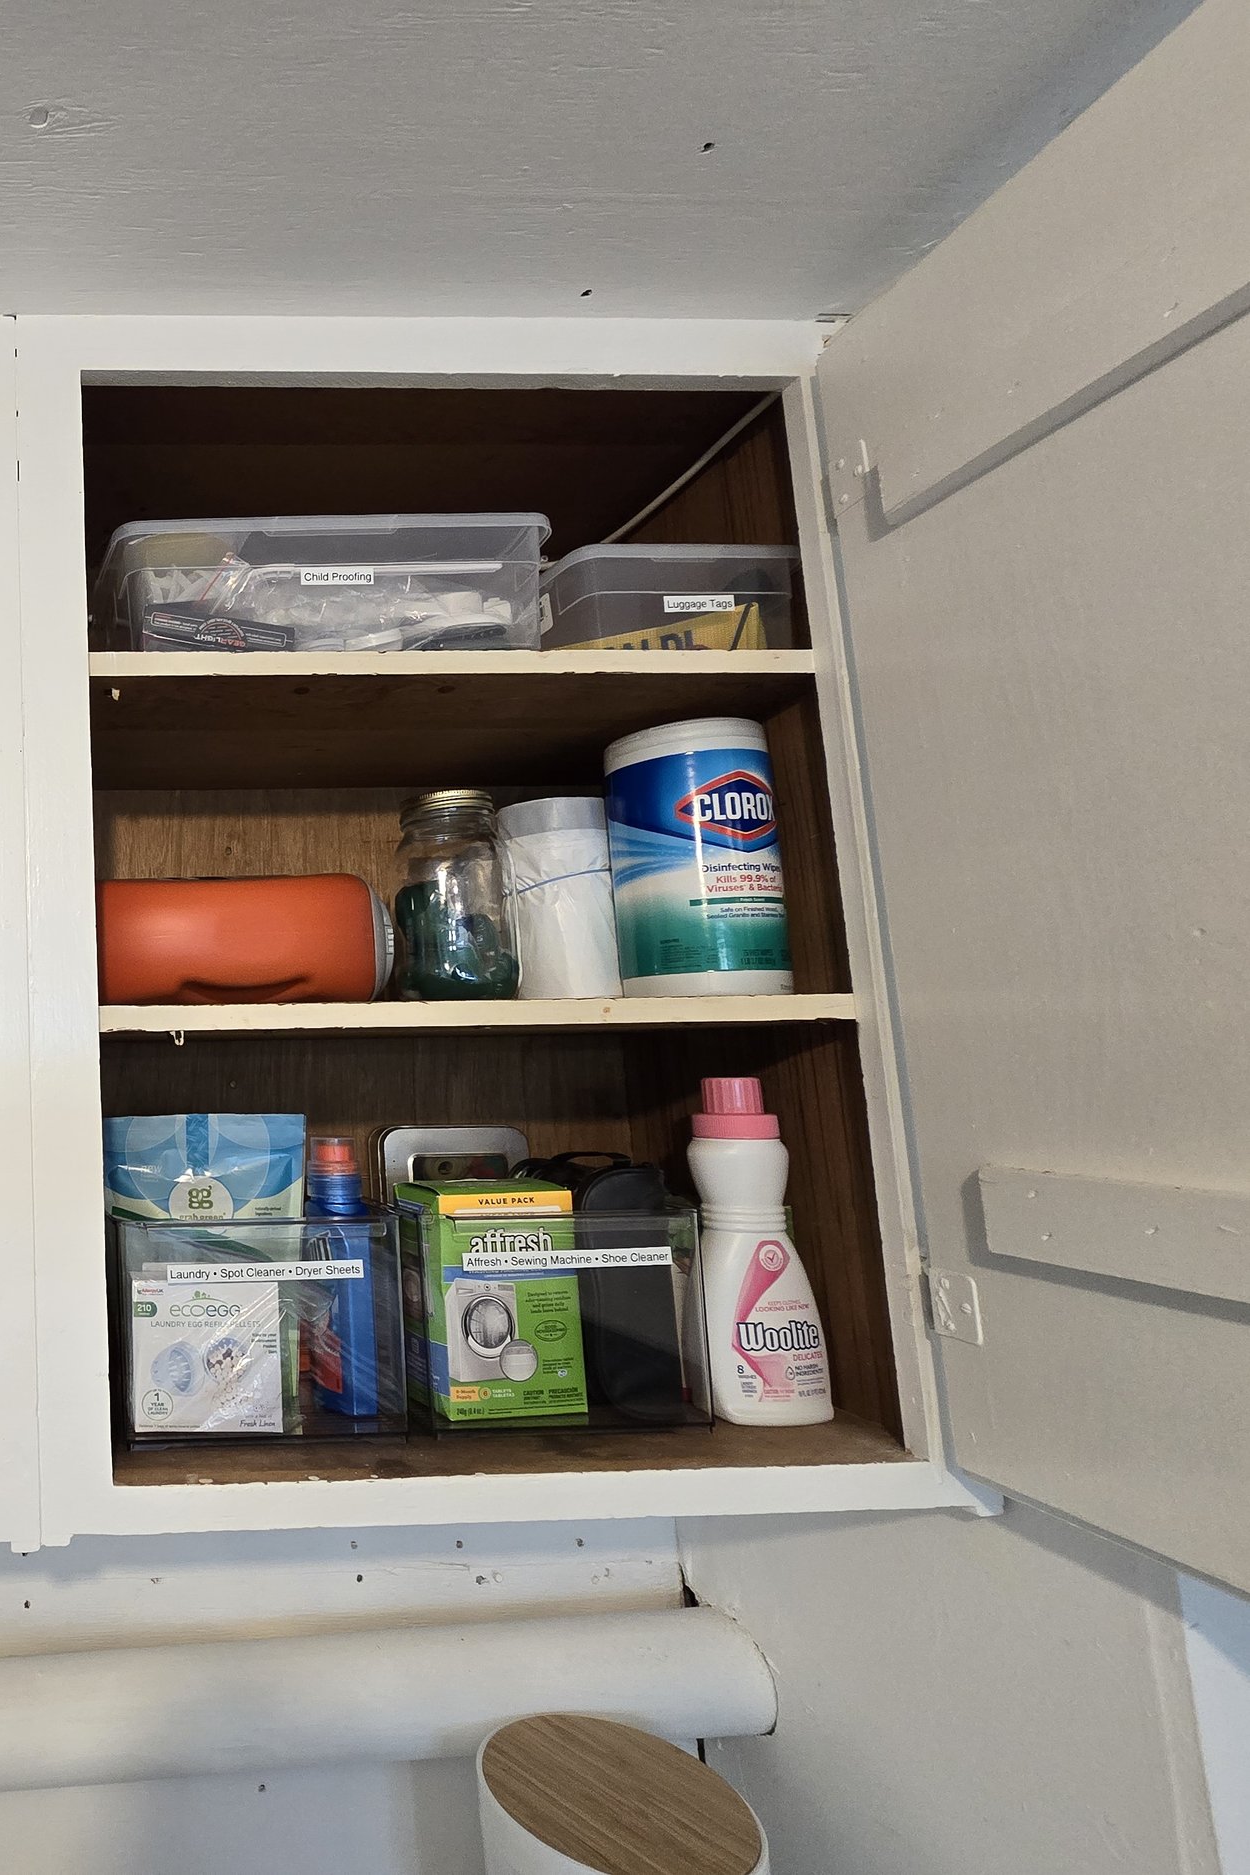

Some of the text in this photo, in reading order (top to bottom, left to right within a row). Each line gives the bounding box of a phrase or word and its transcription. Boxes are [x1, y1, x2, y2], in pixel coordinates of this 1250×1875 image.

[304, 572, 372, 583] Child Proofing
[667, 599, 733, 610] Luggage Tags
[702, 862, 761, 873] Disinfecting
[716, 875, 737, 884] Kills
[739, 874, 768, 883] 99.9%
[748, 883, 755, 891] &
[478, 1197, 535, 1206] VALUE PACK
[470, 1226, 554, 1253] affresh
[466, 1251, 668, 1268] Affresh Sewing Machine Shoe Cleaner
[170, 1265, 361, 1281] Laundry Spot Cleaner Dryer Sheets
[151, 1320, 185, 1328] LAUNDRY
[188, 1320, 203, 1328] EGG
[735, 1320, 820, 1352] Woolite
[793, 1351, 823, 1361] DELICATES
[737, 1365, 744, 1374] 8
[154, 1392, 160, 1401] 1
